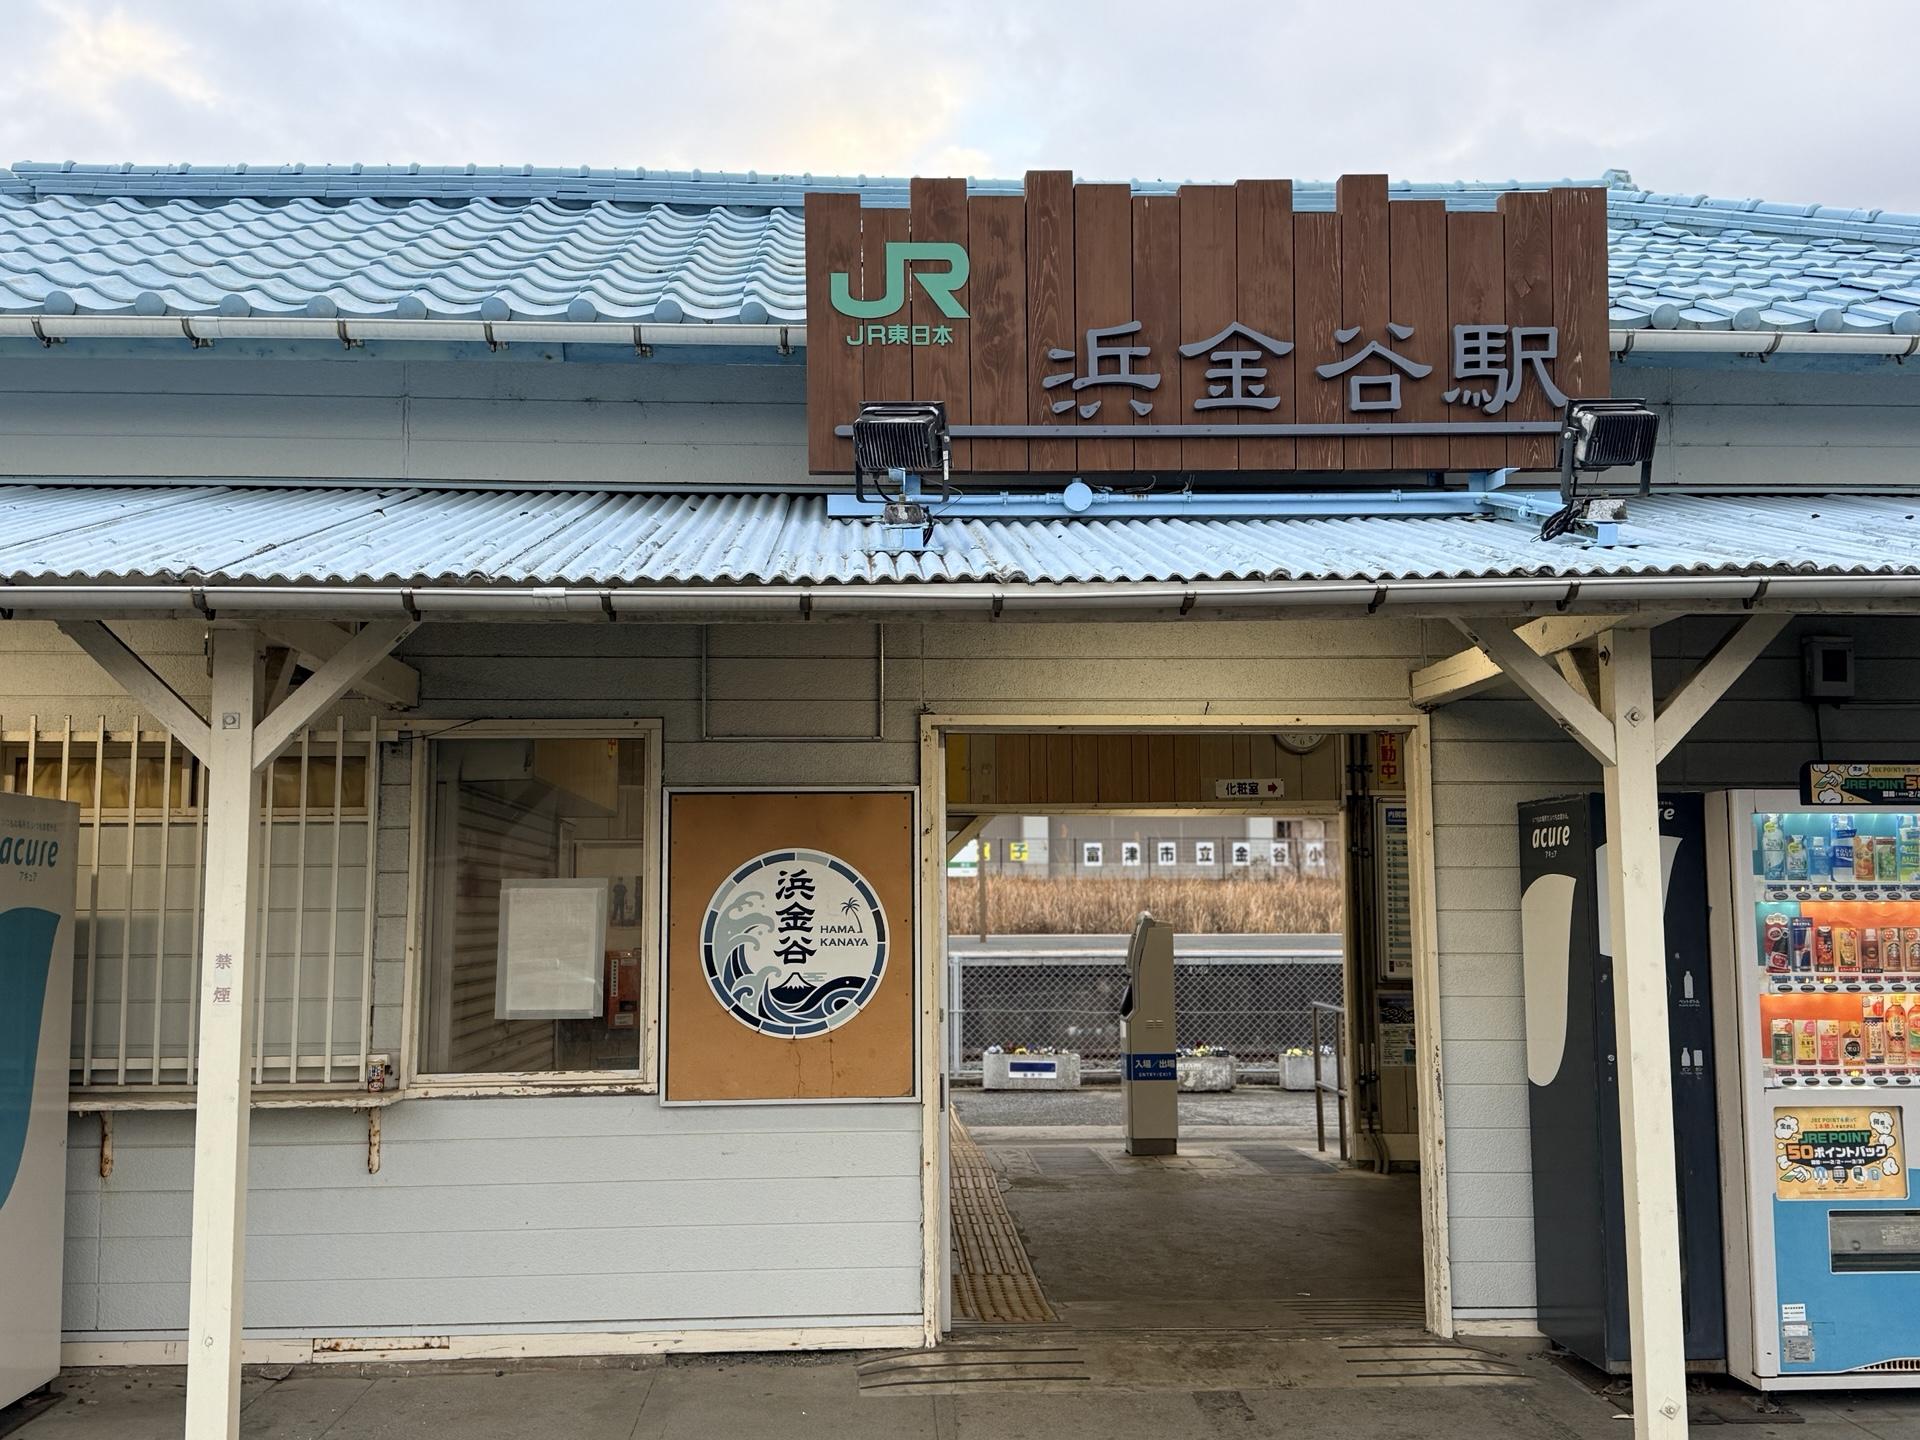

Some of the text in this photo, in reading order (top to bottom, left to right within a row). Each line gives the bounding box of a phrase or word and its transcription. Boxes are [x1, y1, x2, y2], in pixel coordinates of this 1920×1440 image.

[830, 242, 971, 320] JR
[845, 325, 954, 347] JR東日本
[1041, 319, 1569, 419] 浜金谷駅
[1225, 782, 1260, 796] 化粧室
[1843, 778, 1868, 790] JRE
[1869, 778, 1905, 790] POINT
[1531, 824, 1571, 849] acure
[0, 836, 59, 868] acure
[774, 867, 817, 965] 浜金谷
[820, 925, 856, 934] HAMA
[819, 937, 869, 947] KANAYA
[212, 953, 233, 1004] 禁煙
[1799, 1131, 1871, 1144] JRE POINT
[1786, 1144, 1887, 1160] 50ポイントバック
